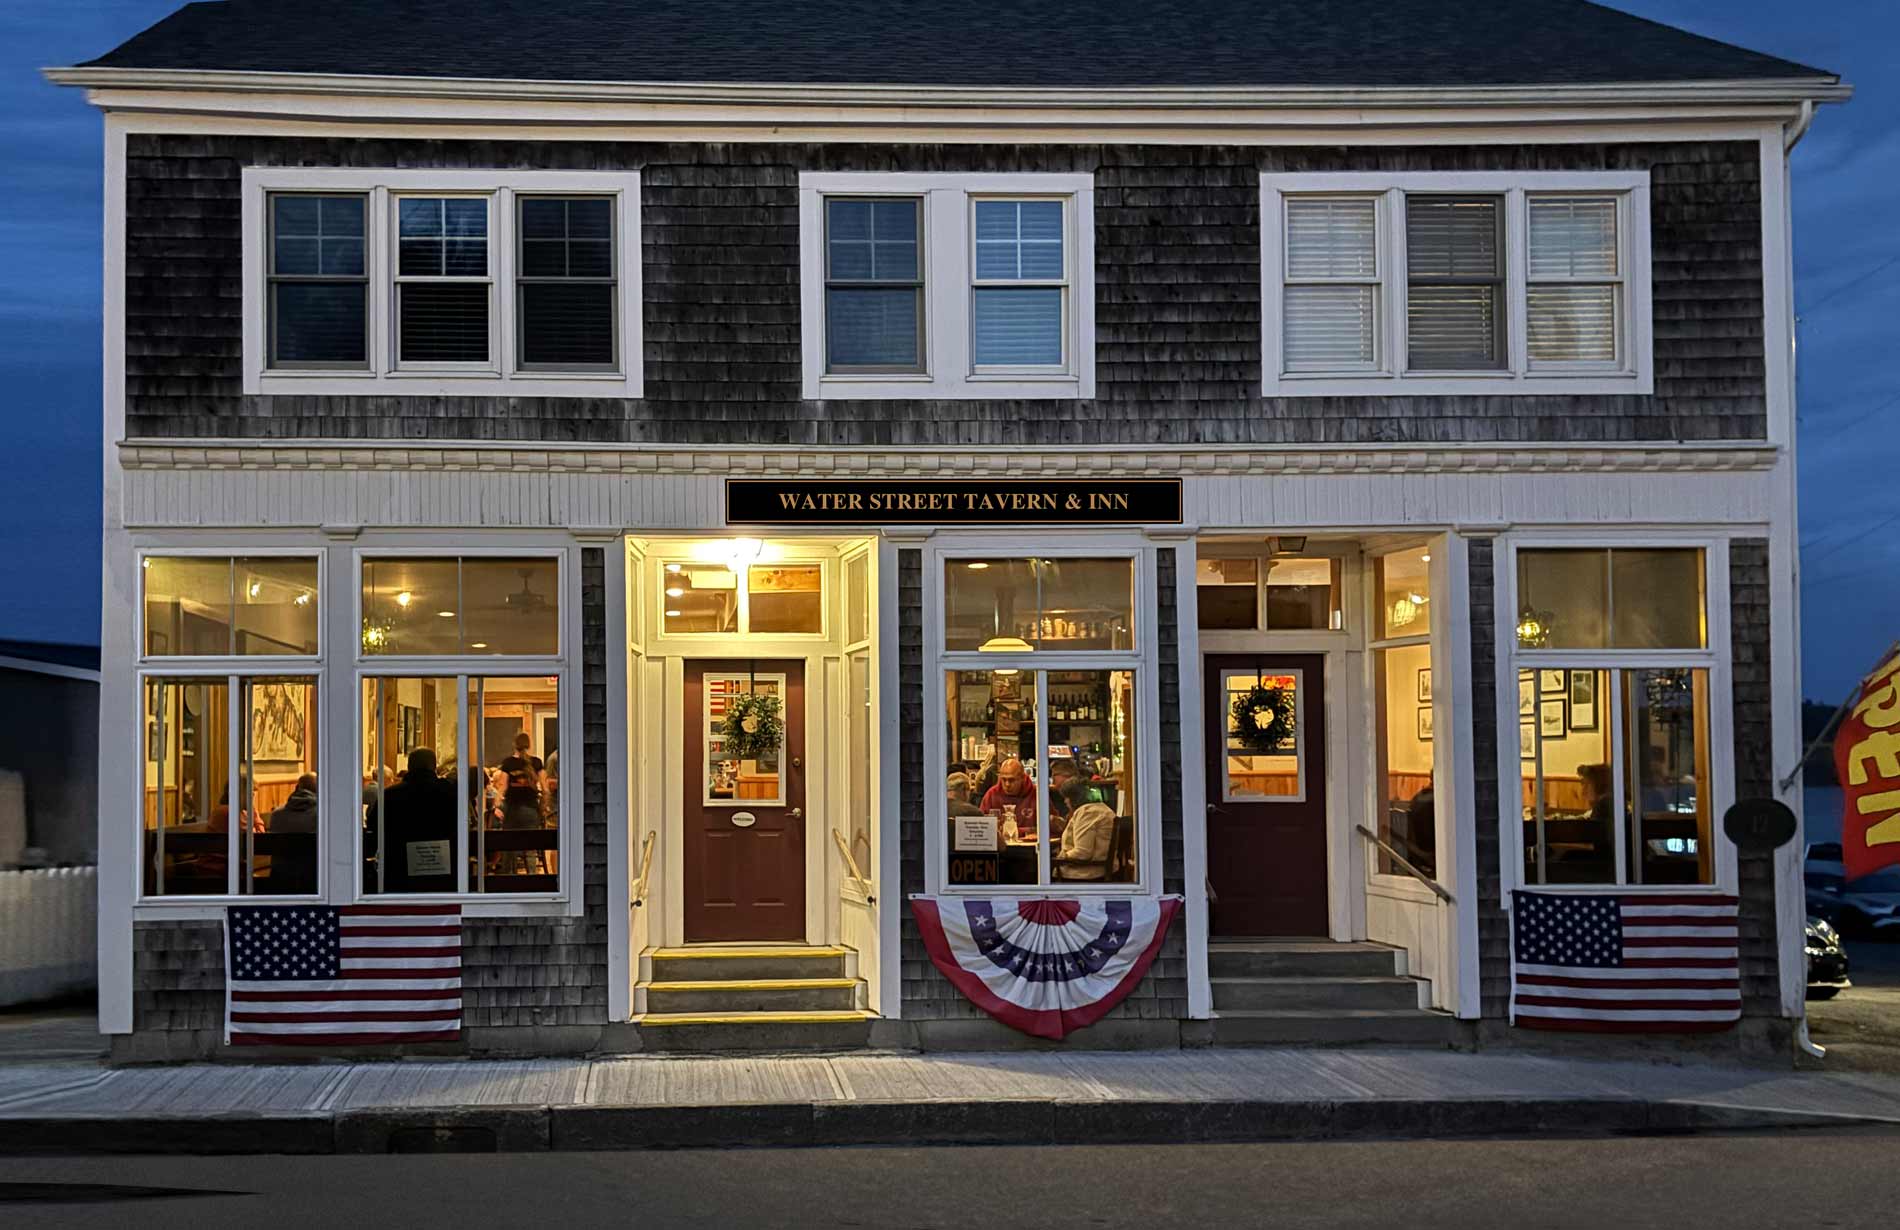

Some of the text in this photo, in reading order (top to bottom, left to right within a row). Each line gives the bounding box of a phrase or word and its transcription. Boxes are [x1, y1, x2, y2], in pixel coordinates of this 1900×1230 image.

[778, 493, 1129, 510] WATER STREET TAVERN & INN
[952, 859, 995, 881] OPEN
